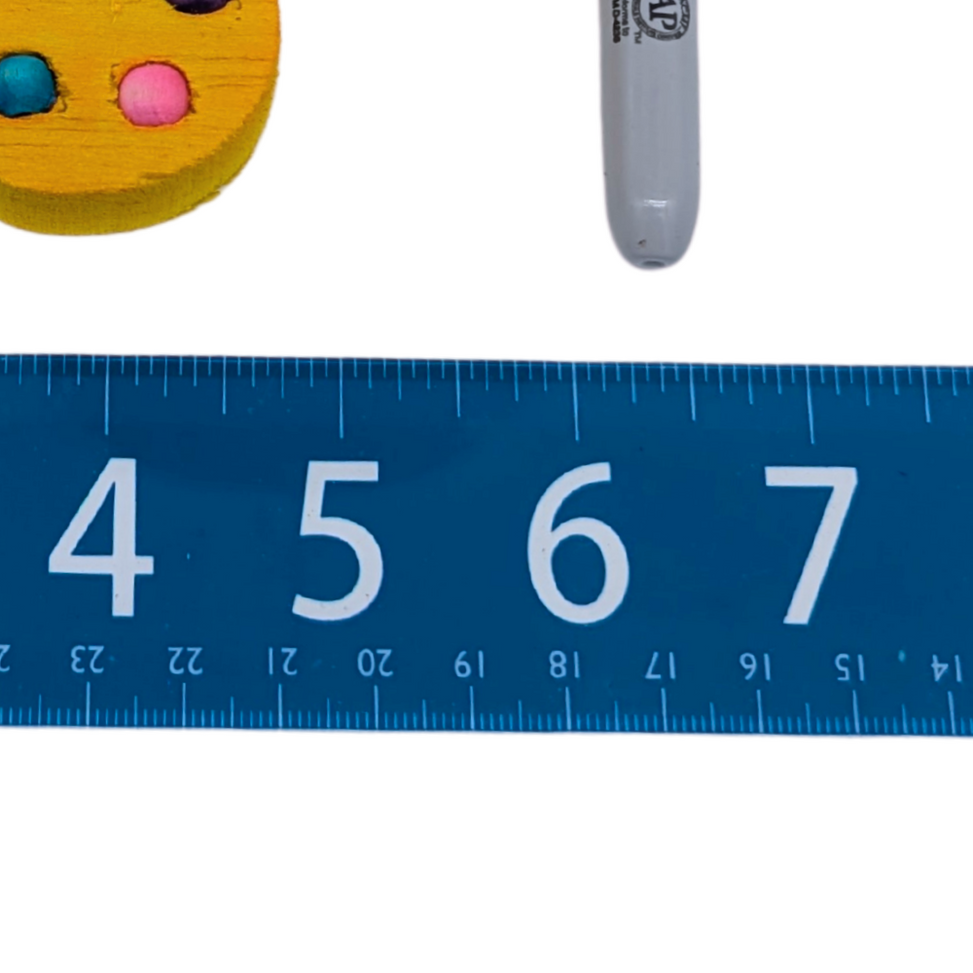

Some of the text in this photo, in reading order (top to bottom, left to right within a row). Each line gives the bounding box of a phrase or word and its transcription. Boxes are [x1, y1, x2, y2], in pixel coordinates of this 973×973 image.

[49, 459, 153, 616] 4
[293, 462, 382, 620] 5
[528, 463, 628, 623] 6
[766, 467, 857, 624] 7
[70, 644, 105, 674] 23
[167, 646, 204, 676] 22
[268, 646, 298, 676] 21
[357, 648, 394, 678] 20
[454, 650, 484, 679] 19
[548, 649, 581, 679] 18
[644, 651, 677, 680] 17
[739, 652, 771, 682] 16
[834, 653, 865, 682] 15
[930, 654, 963, 683] 14
